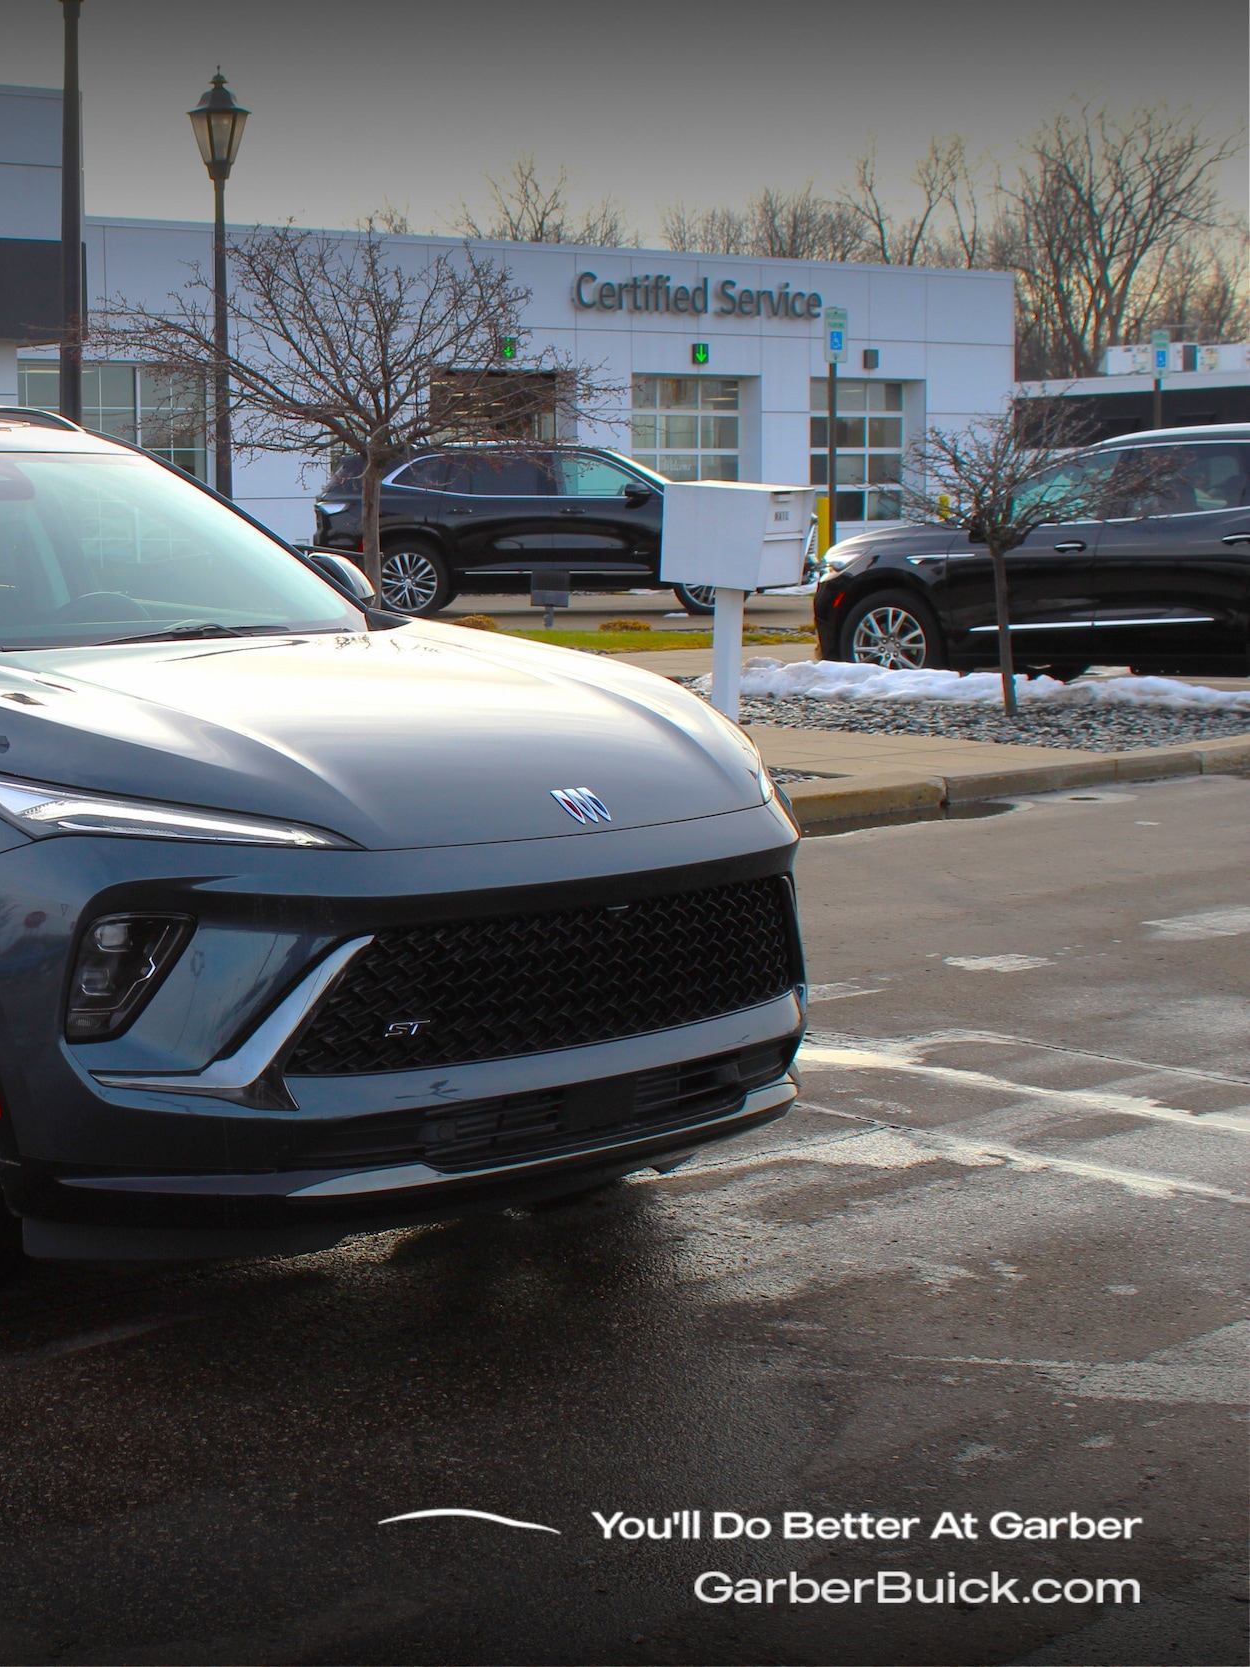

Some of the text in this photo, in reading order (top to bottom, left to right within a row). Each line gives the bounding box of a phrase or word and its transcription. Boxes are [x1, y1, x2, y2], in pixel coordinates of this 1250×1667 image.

[572, 271, 823, 319] Certified Service
[384, 1019, 431, 1038] ST
